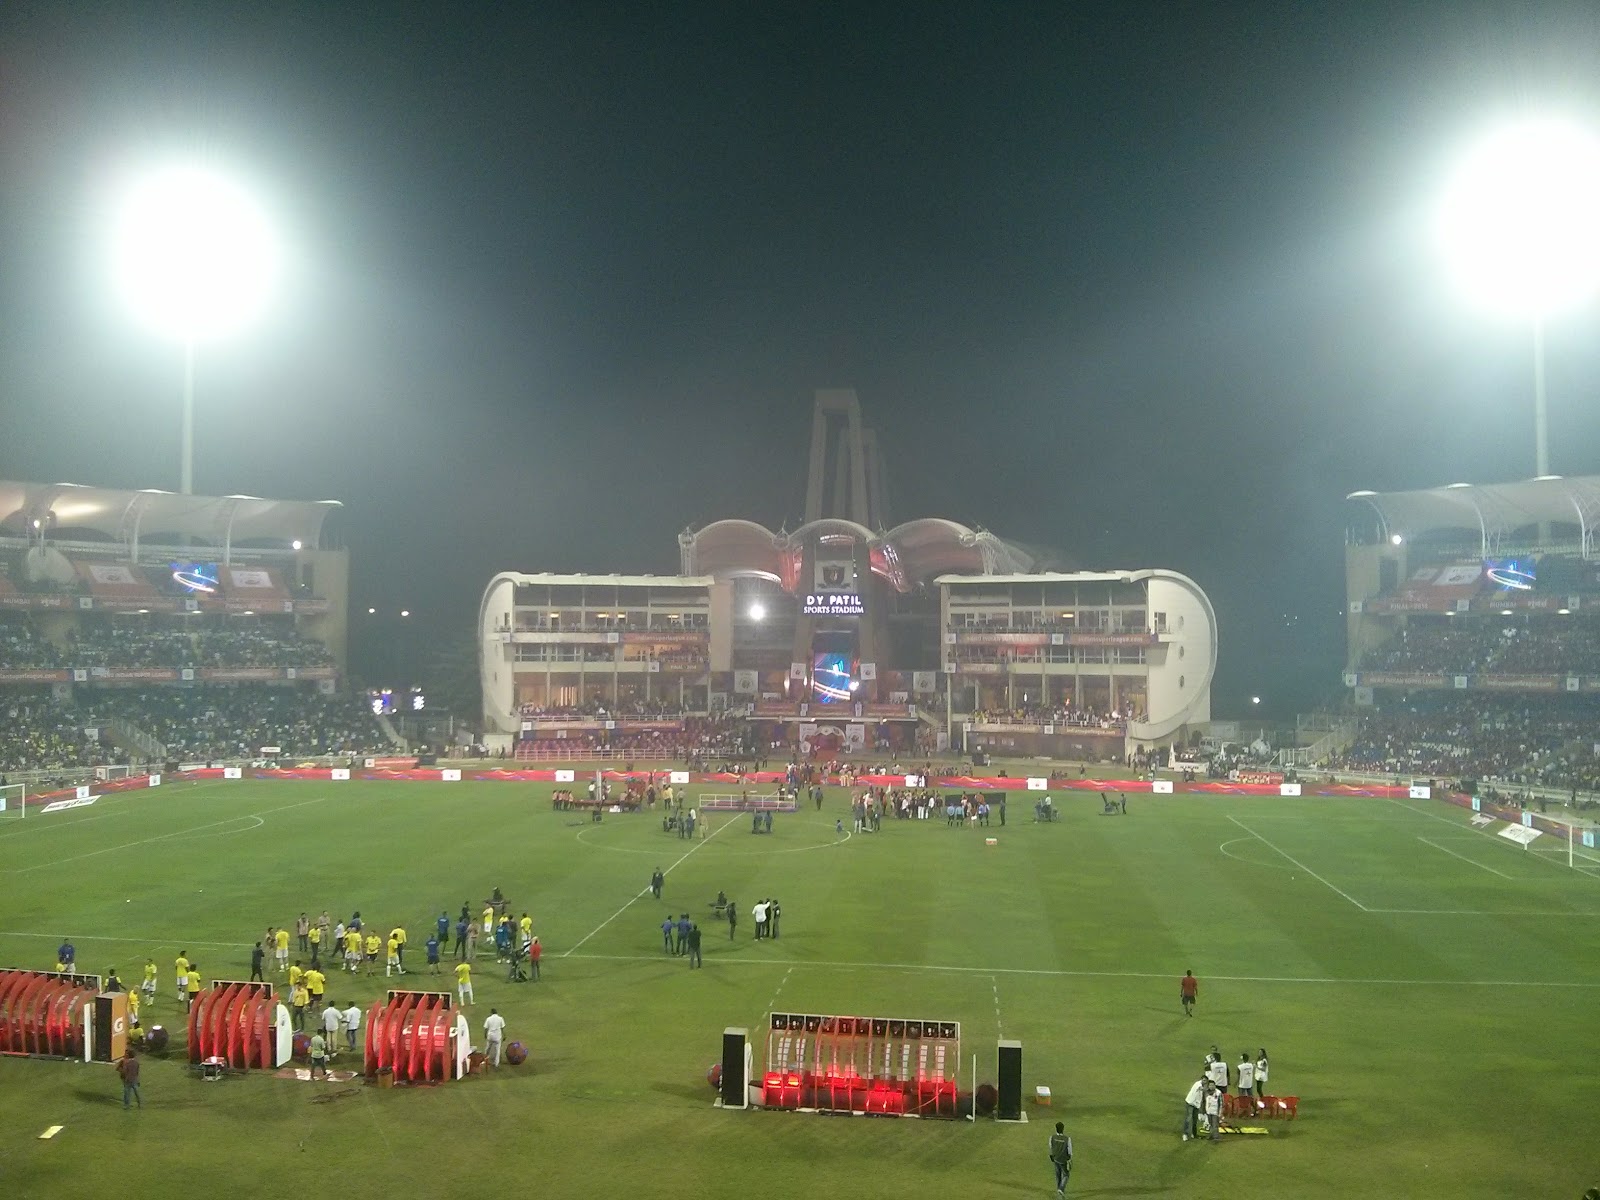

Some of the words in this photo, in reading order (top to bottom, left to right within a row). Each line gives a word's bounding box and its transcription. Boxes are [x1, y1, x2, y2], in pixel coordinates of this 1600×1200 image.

[829, 595, 862, 606] PATIL
[803, 606, 830, 614] SPORTS
[831, 606, 864, 614] STADIUM
